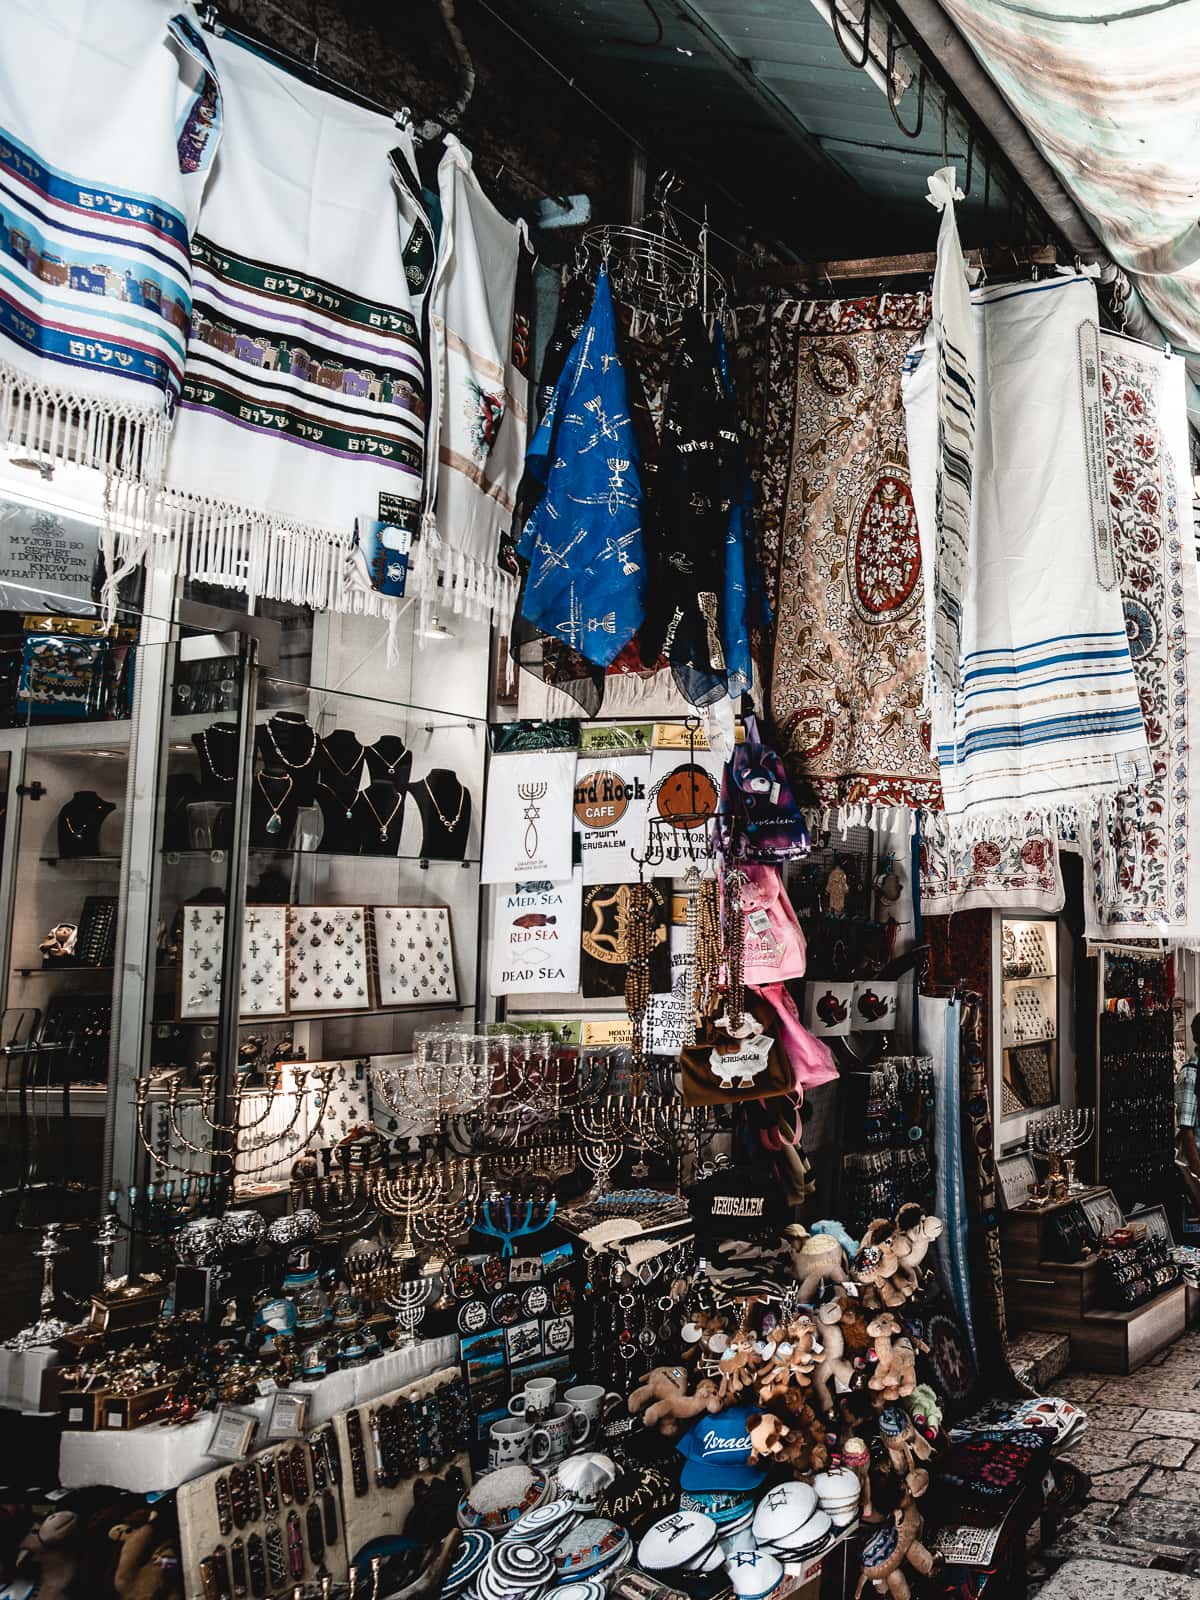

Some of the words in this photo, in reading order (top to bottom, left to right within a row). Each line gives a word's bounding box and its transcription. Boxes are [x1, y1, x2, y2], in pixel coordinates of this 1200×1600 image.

[78, 191, 175, 230] ירושלים
[263, 276, 341, 309] ירושלים
[69, 339, 134, 367] שלום
[184, 385, 216, 403] עיר
[239, 406, 290, 428] שלום
[297, 422, 324, 441] עיר
[348, 438, 395, 457] שלום
[10, 536, 29, 545] MY
[30, 538, 52, 547] JOB
[25, 546, 71, 557] SECRET
[30, 563, 68, 573] KNOW
[54, 556, 87, 567] EVEN
[603, 777, 645, 802] Rock
[585, 806, 615, 819] CAFE
[585, 830, 618, 840] ירושלים
[541, 894, 563, 905] SEA
[509, 932, 532, 943] RED
[535, 929, 559, 941] SEA
[502, 970, 534, 983] DEAD
[538, 967, 566, 980] SEA
[663, 1030, 687, 1040] KNO
[711, 1196, 765, 1217] JERUSALEM
[703, 1430, 753, 1450] Israel
